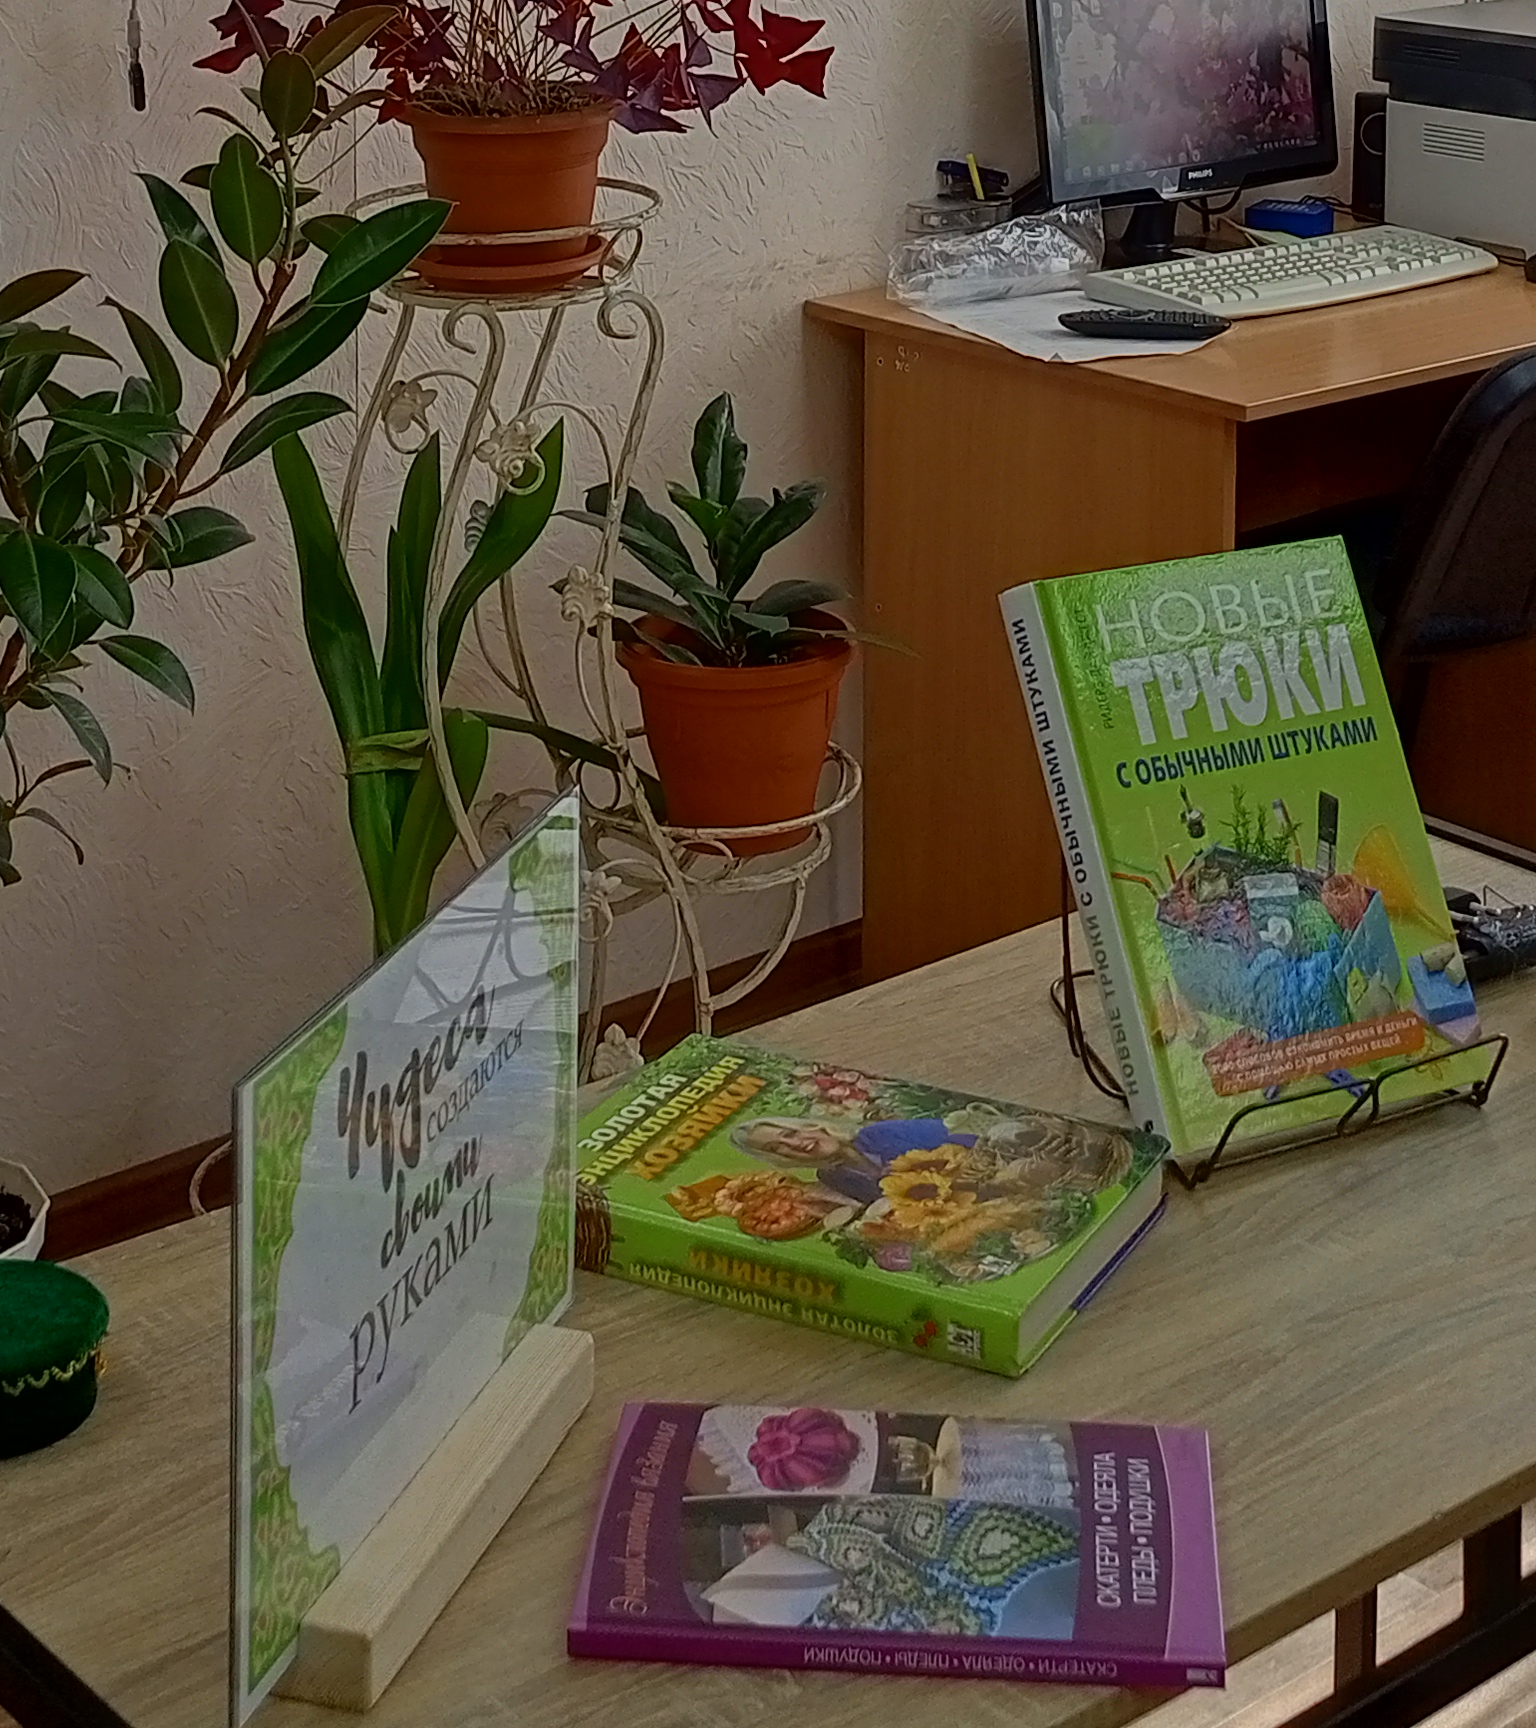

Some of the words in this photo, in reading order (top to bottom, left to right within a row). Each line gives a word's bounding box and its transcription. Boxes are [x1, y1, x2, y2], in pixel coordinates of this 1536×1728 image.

[1095, 568, 1342, 654] НОВЫЕ
[1012, 618, 1051, 733] ШТУКАМИ
[1110, 623, 1367, 746] ТРЮКИ
[1115, 761, 1132, 789] С
[1134, 736, 1266, 786] ОБЫЧНЫМИ
[1266, 716, 1379, 761] ШТУКАМИ
[1042, 739, 1087, 884] ОБЫЧНЫМИ
[1080, 891, 1093, 907] С
[1085, 915, 1116, 1000] ТРЮКИ
[1111, 1007, 1139, 1096] НОВЫЕ
[1328, 1043, 1370, 1061] ПРОСТЫХ
[1370, 1034, 1402, 1051] ВЕЩЕЙ
[1344, 1026, 1377, 1043] ВРЕМЯ
[1384, 1016, 1418, 1034] ДЕНЬГИ
[337, 983, 496, 1194] Чудеса
[426, 1019, 524, 1144] создаются
[576, 1073, 689, 1152] ЗОЛОТАЯ
[576, 1055, 747, 1186] ЭНЦИКЛОПЕДИЯ
[632, 1075, 766, 1181] ХОЗЯЙКИ
[381, 1133, 483, 1269] своими
[348, 1173, 495, 1416] руками
[628, 1261, 794, 1317] ЭНЦИКЛОПЕДИЯ
[688, 1246, 839, 1302] ХОЗЯЙКИ
[801, 1307, 899, 1344] ЗОЛОТАЯ
[1093, 1450, 1121, 1515] ОДЕЯЛА
[1126, 1457, 1156, 1536] ПОДУШКИ
[1095, 1524, 1122, 1610] СКАТЕРТИ
[1131, 1546, 1159, 1606] ПЛЕДЫ
[803, 1645, 883, 1665] ПОДУШКИ
[894, 1649, 950, 1669] ПЛЕДЫ
[962, 1654, 1026, 1674] ОДЕЯЛА
[1036, 1657, 1118, 1679] СКАТЕРТИ
